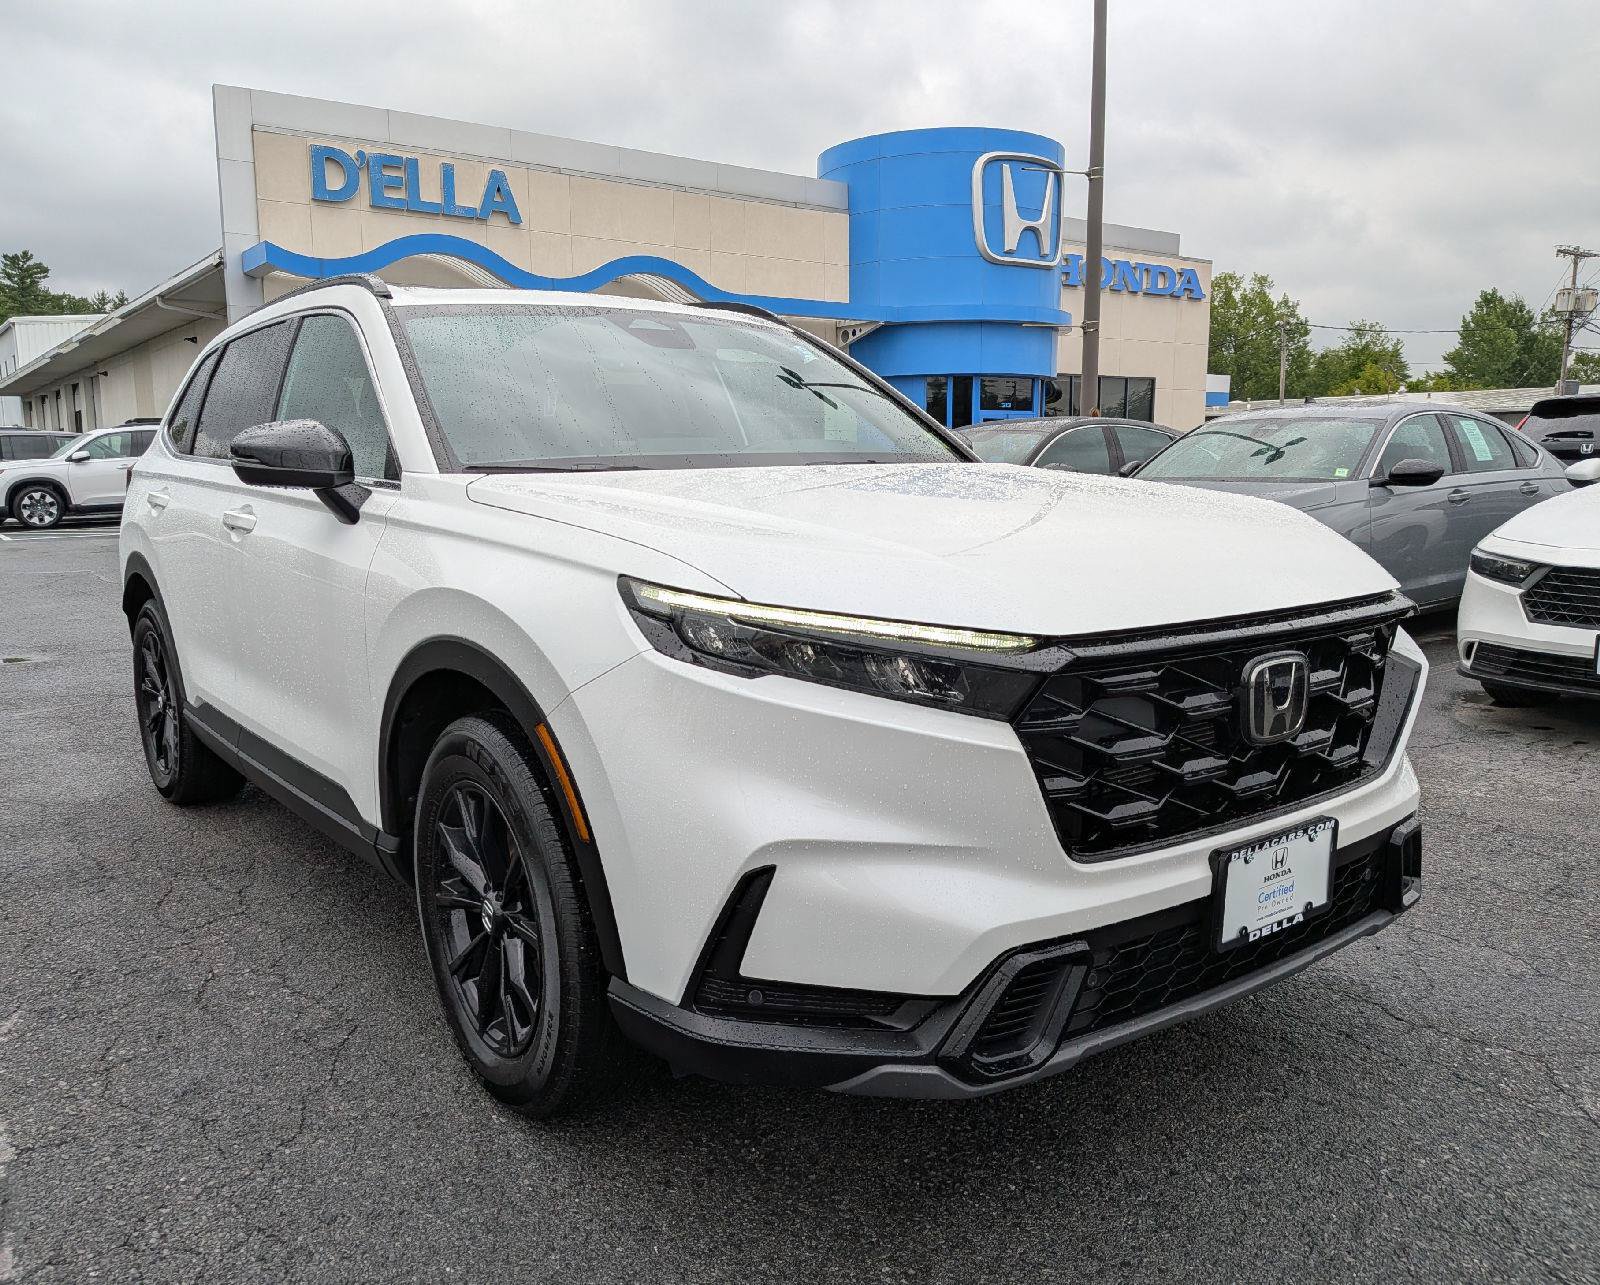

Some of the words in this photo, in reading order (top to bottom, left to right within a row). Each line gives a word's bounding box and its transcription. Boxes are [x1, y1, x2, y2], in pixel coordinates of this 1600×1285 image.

[310, 143, 523, 225] D'ELLA
[1231, 820, 1335, 862] DELLACARS.COM
[1263, 867, 1292, 883] HONDA
[1258, 880, 1295, 904] Certified
[1248, 913, 1304, 942] DELLA
